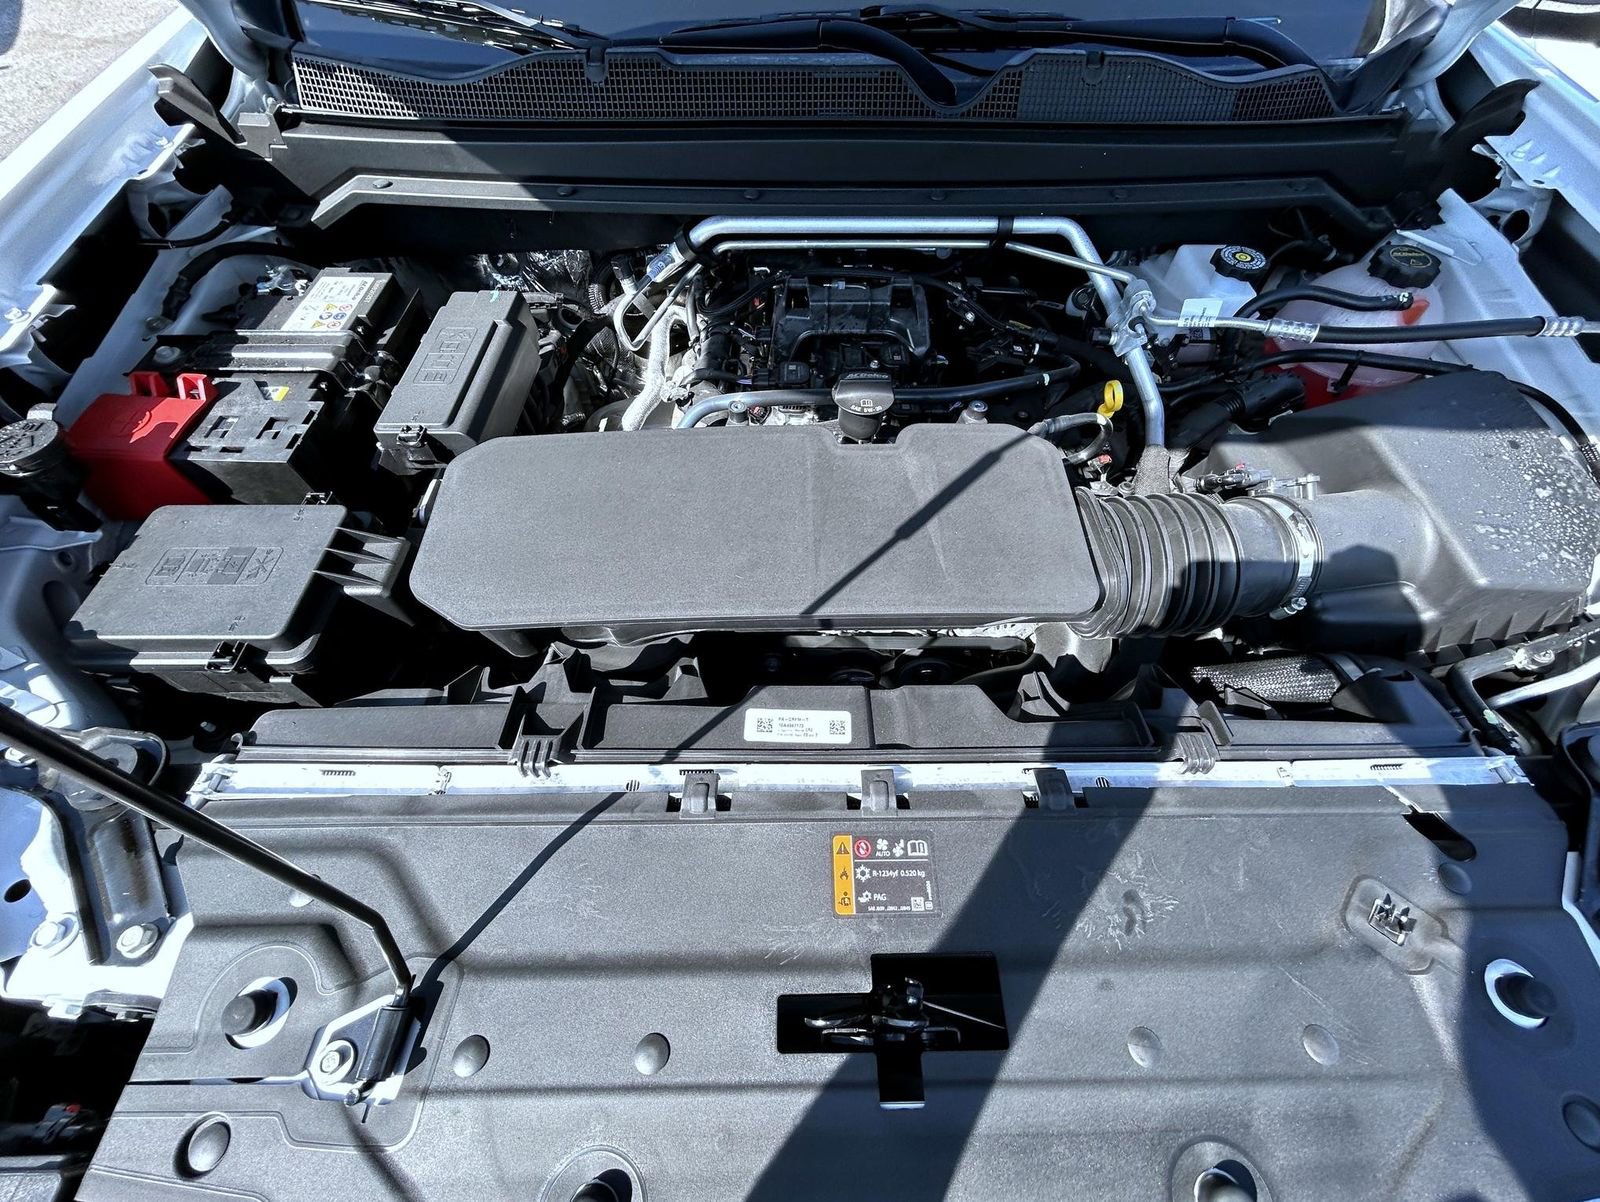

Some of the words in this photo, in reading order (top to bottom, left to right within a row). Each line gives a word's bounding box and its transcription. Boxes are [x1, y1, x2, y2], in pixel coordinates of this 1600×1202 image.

[872, 869, 899, 878] R-1234yf
[917, 869, 926, 878] kg
[873, 893, 887, 901] PAG
